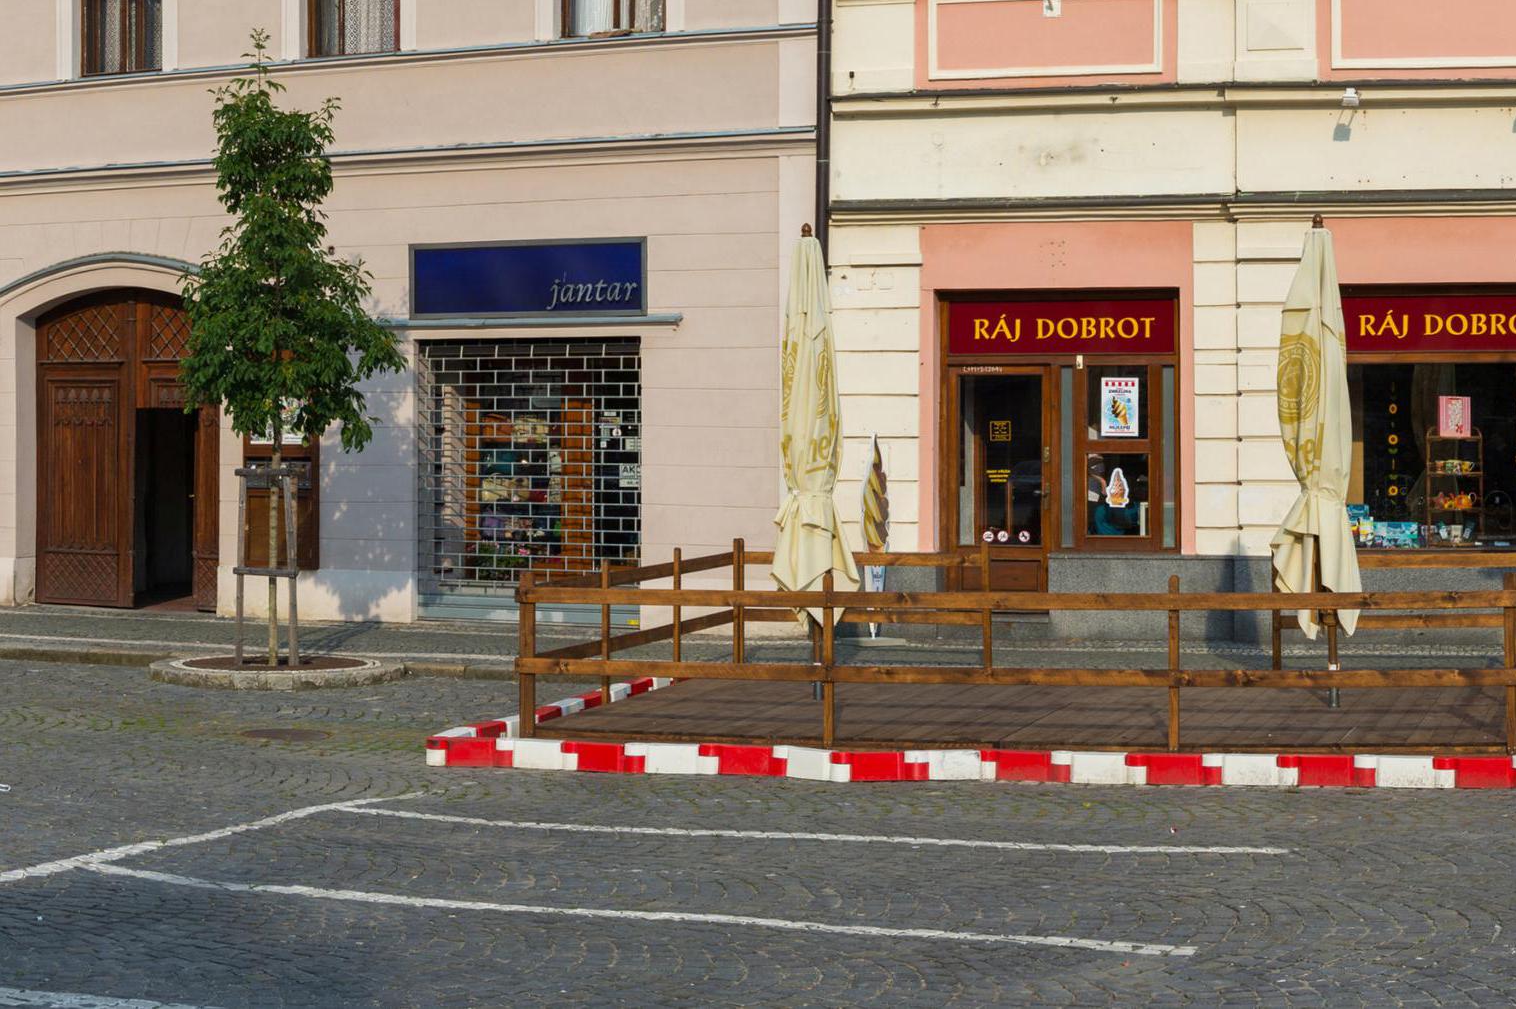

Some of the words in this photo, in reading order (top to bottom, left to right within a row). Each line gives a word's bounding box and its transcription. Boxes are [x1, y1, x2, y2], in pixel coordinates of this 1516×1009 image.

[545, 279, 638, 310] jantar
[973, 313, 1021, 343] RÁJ
[1036, 317, 1155, 340] DOBROT
[1358, 309, 1409, 339] RÁJ
